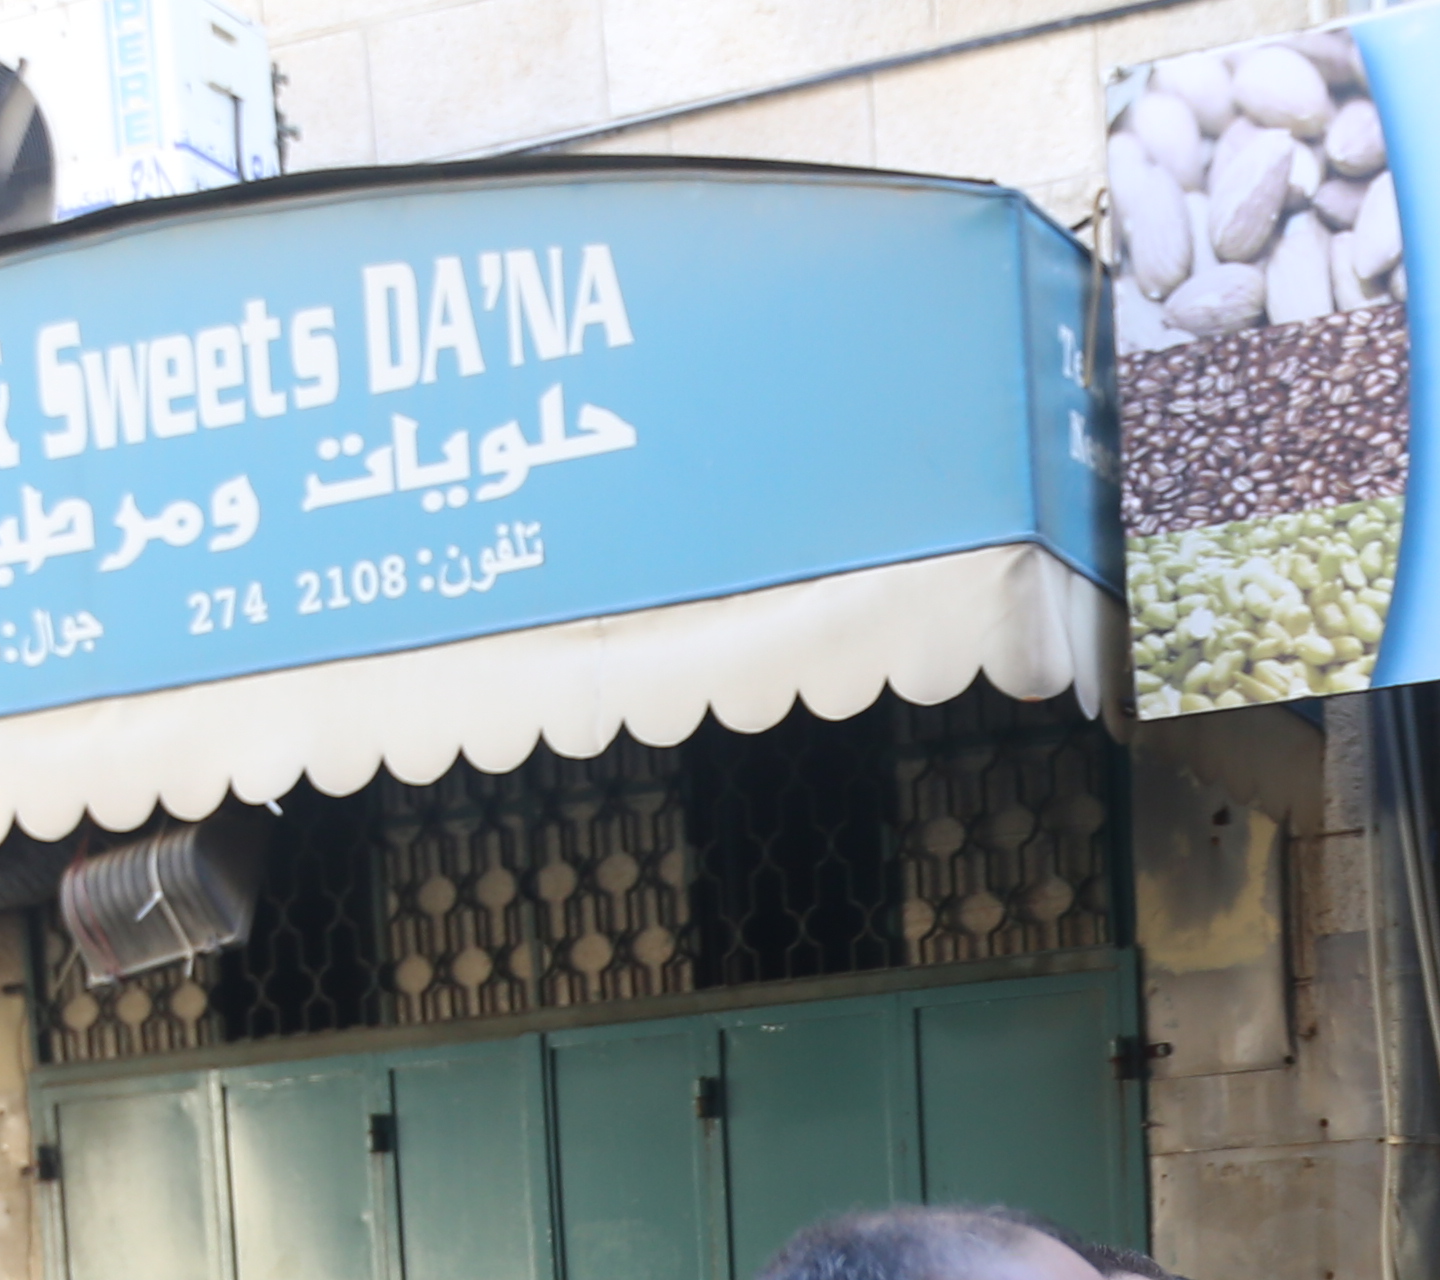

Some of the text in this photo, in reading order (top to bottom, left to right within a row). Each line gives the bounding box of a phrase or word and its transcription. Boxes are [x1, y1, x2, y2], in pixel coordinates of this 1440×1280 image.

[35, 297, 342, 461] Sweets
[302, 382, 639, 514] حلويات
[187, 579, 269, 637] 274
[295, 552, 407, 616] 2108
